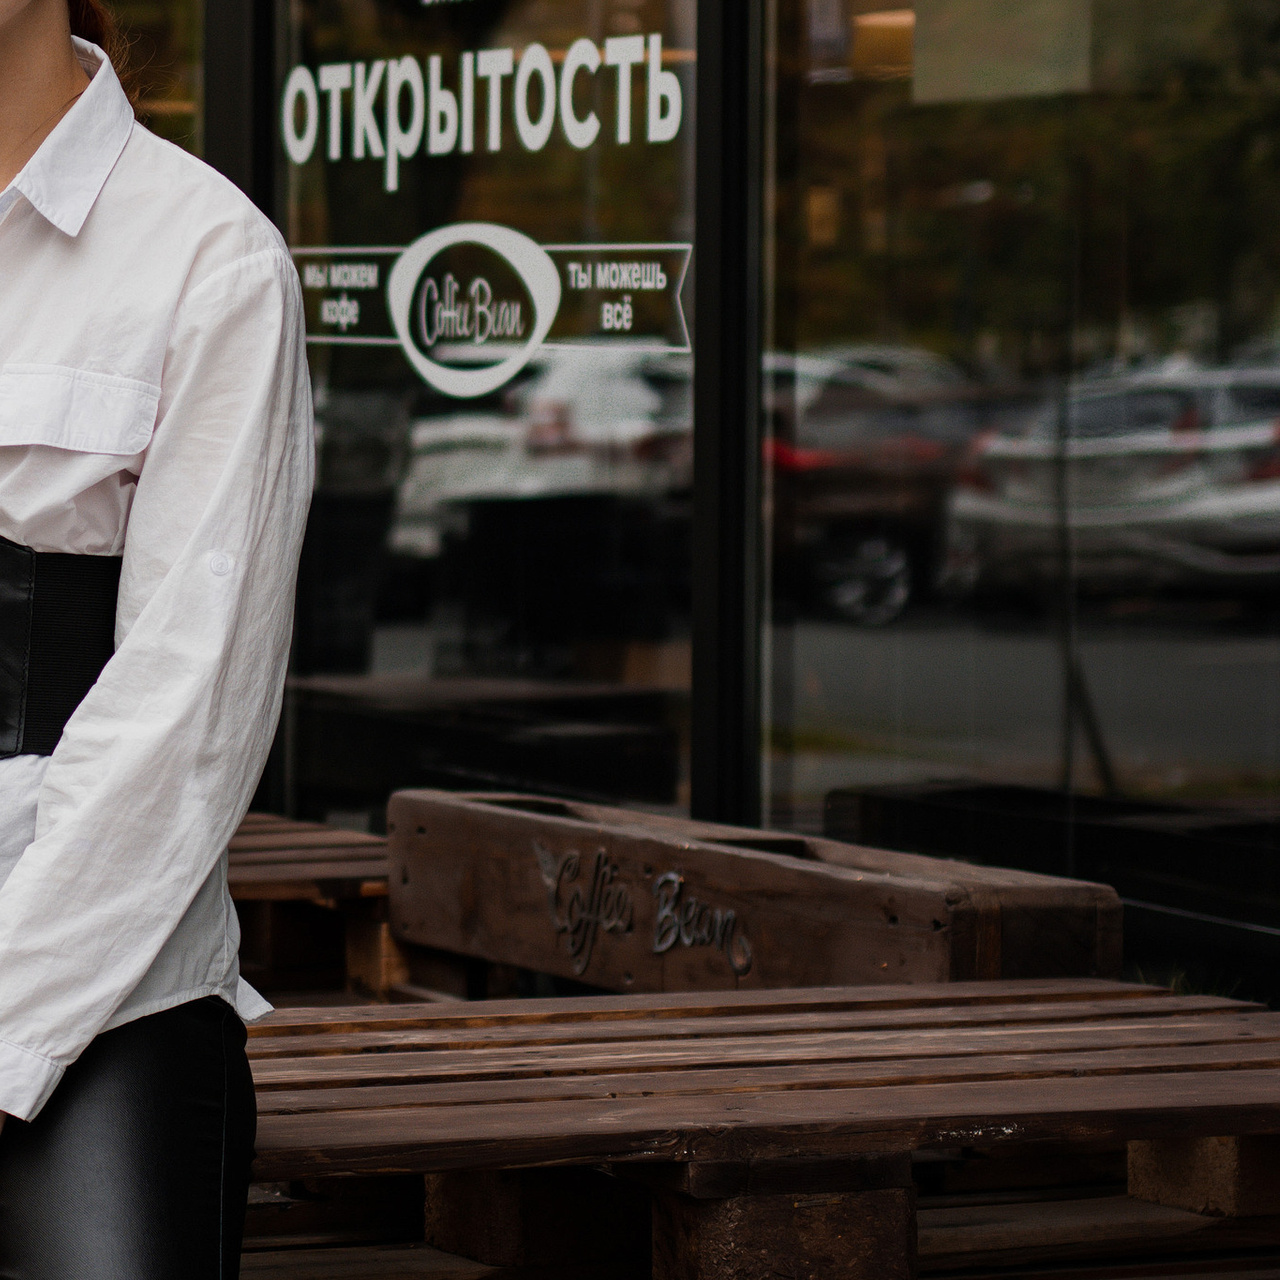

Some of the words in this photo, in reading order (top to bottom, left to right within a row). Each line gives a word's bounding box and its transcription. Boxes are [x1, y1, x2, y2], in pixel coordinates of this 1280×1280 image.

[568, 262, 592, 290] ты
[596, 262, 667, 290] можешь
[602, 294, 633, 331] всё
[554, 846, 634, 976] Coffee
[654, 871, 752, 976] Bean
